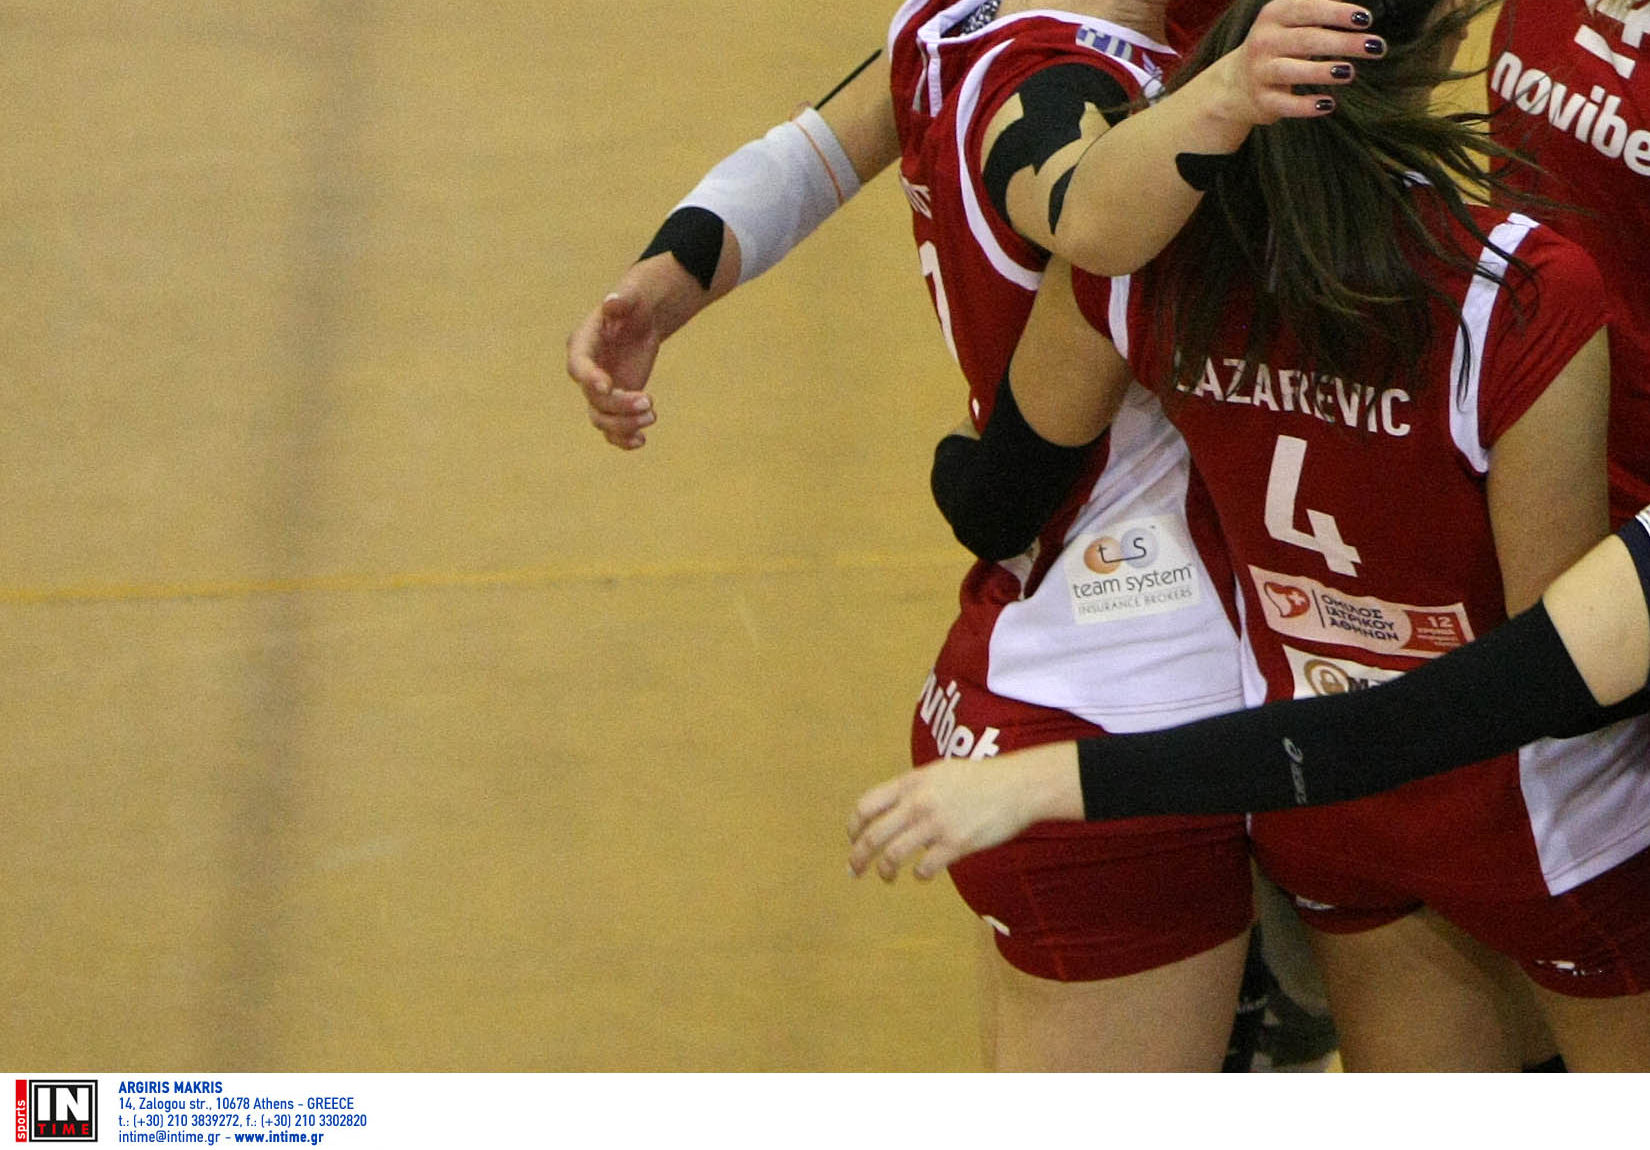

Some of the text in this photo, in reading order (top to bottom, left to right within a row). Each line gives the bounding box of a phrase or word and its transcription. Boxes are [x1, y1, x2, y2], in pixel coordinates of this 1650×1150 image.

[1263, 435, 1362, 578] 4
[1072, 565, 1193, 600] team system
[1426, 615, 1454, 629] 12
[918, 666, 1001, 762] vibet
